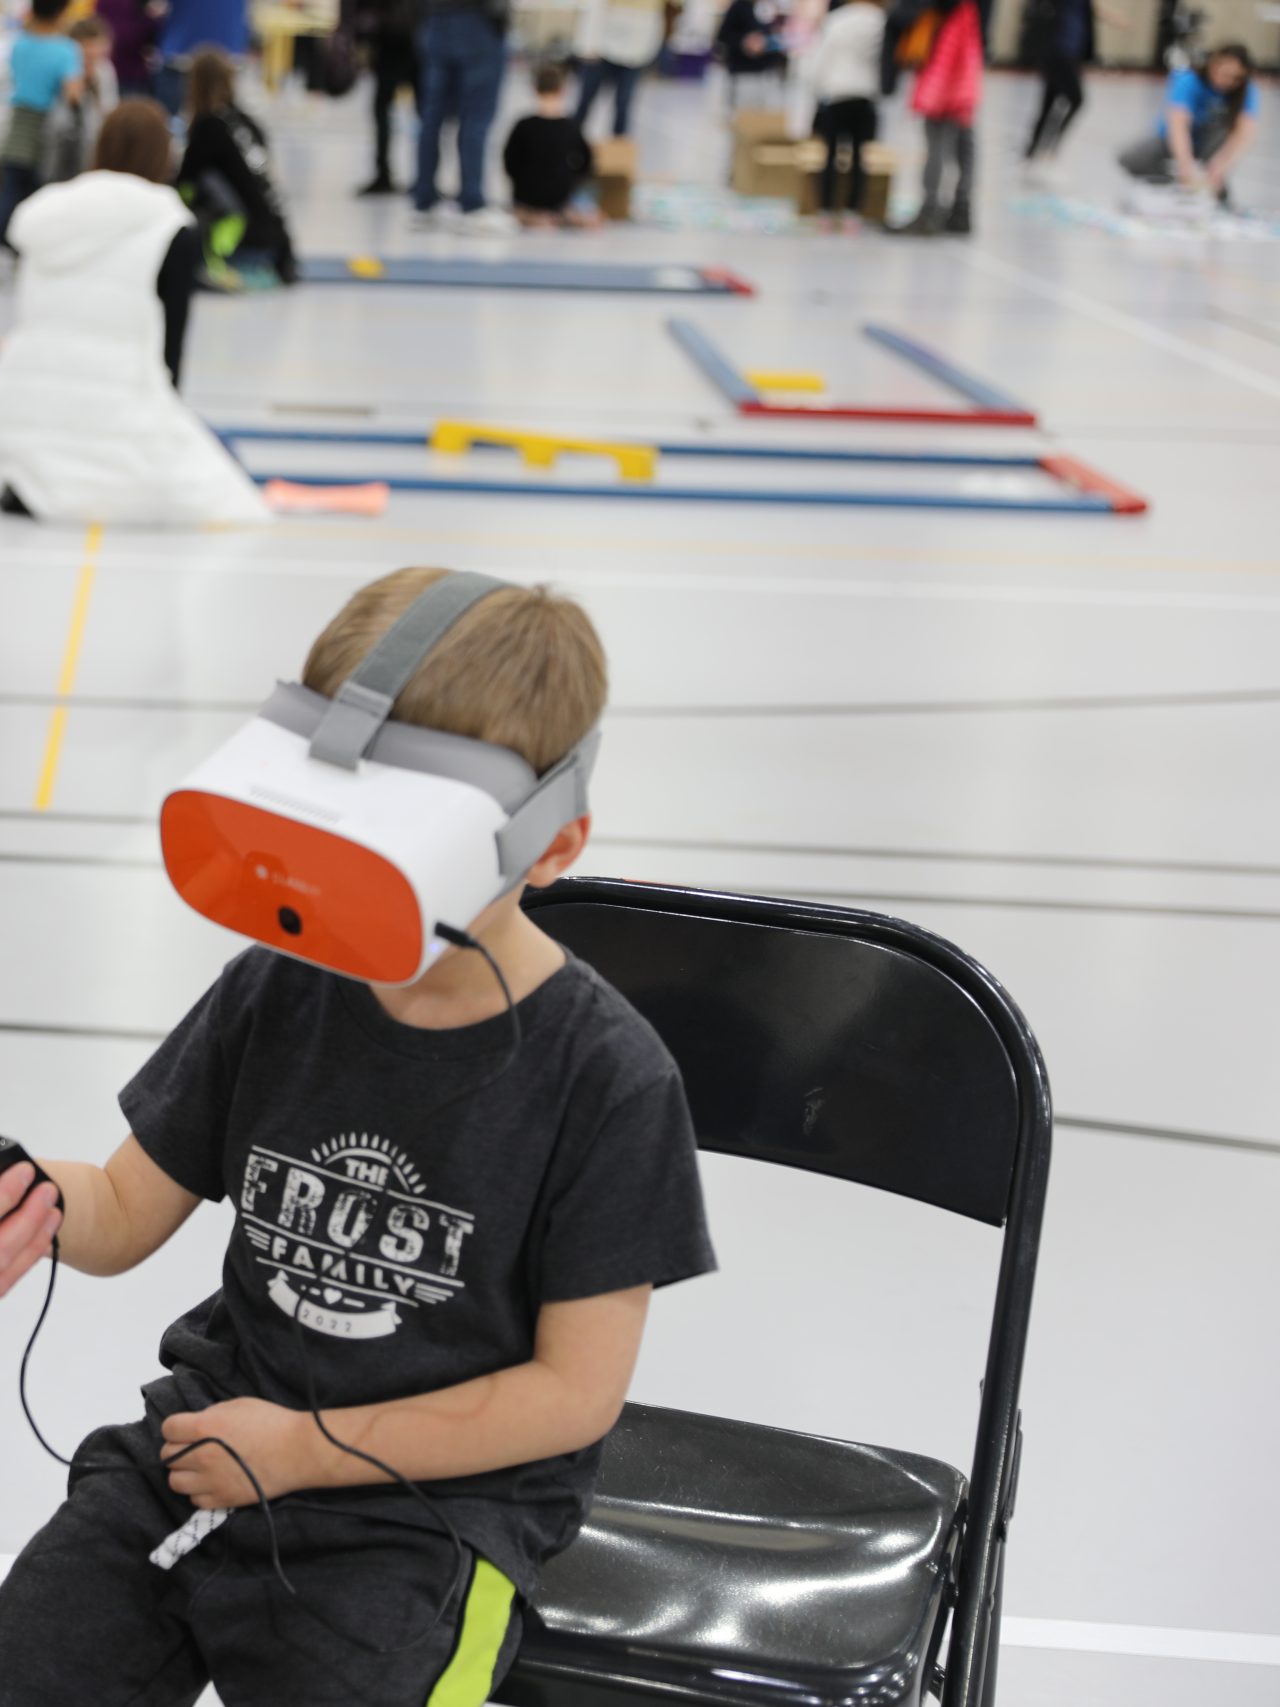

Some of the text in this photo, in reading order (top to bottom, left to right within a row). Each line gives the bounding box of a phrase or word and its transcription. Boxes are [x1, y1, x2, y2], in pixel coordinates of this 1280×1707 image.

[345, 1157, 390, 1186] THE
[241, 1153, 475, 1277] FROST
[272, 1237, 416, 1296] FAMILY
[302, 1308, 353, 1333] 2022
